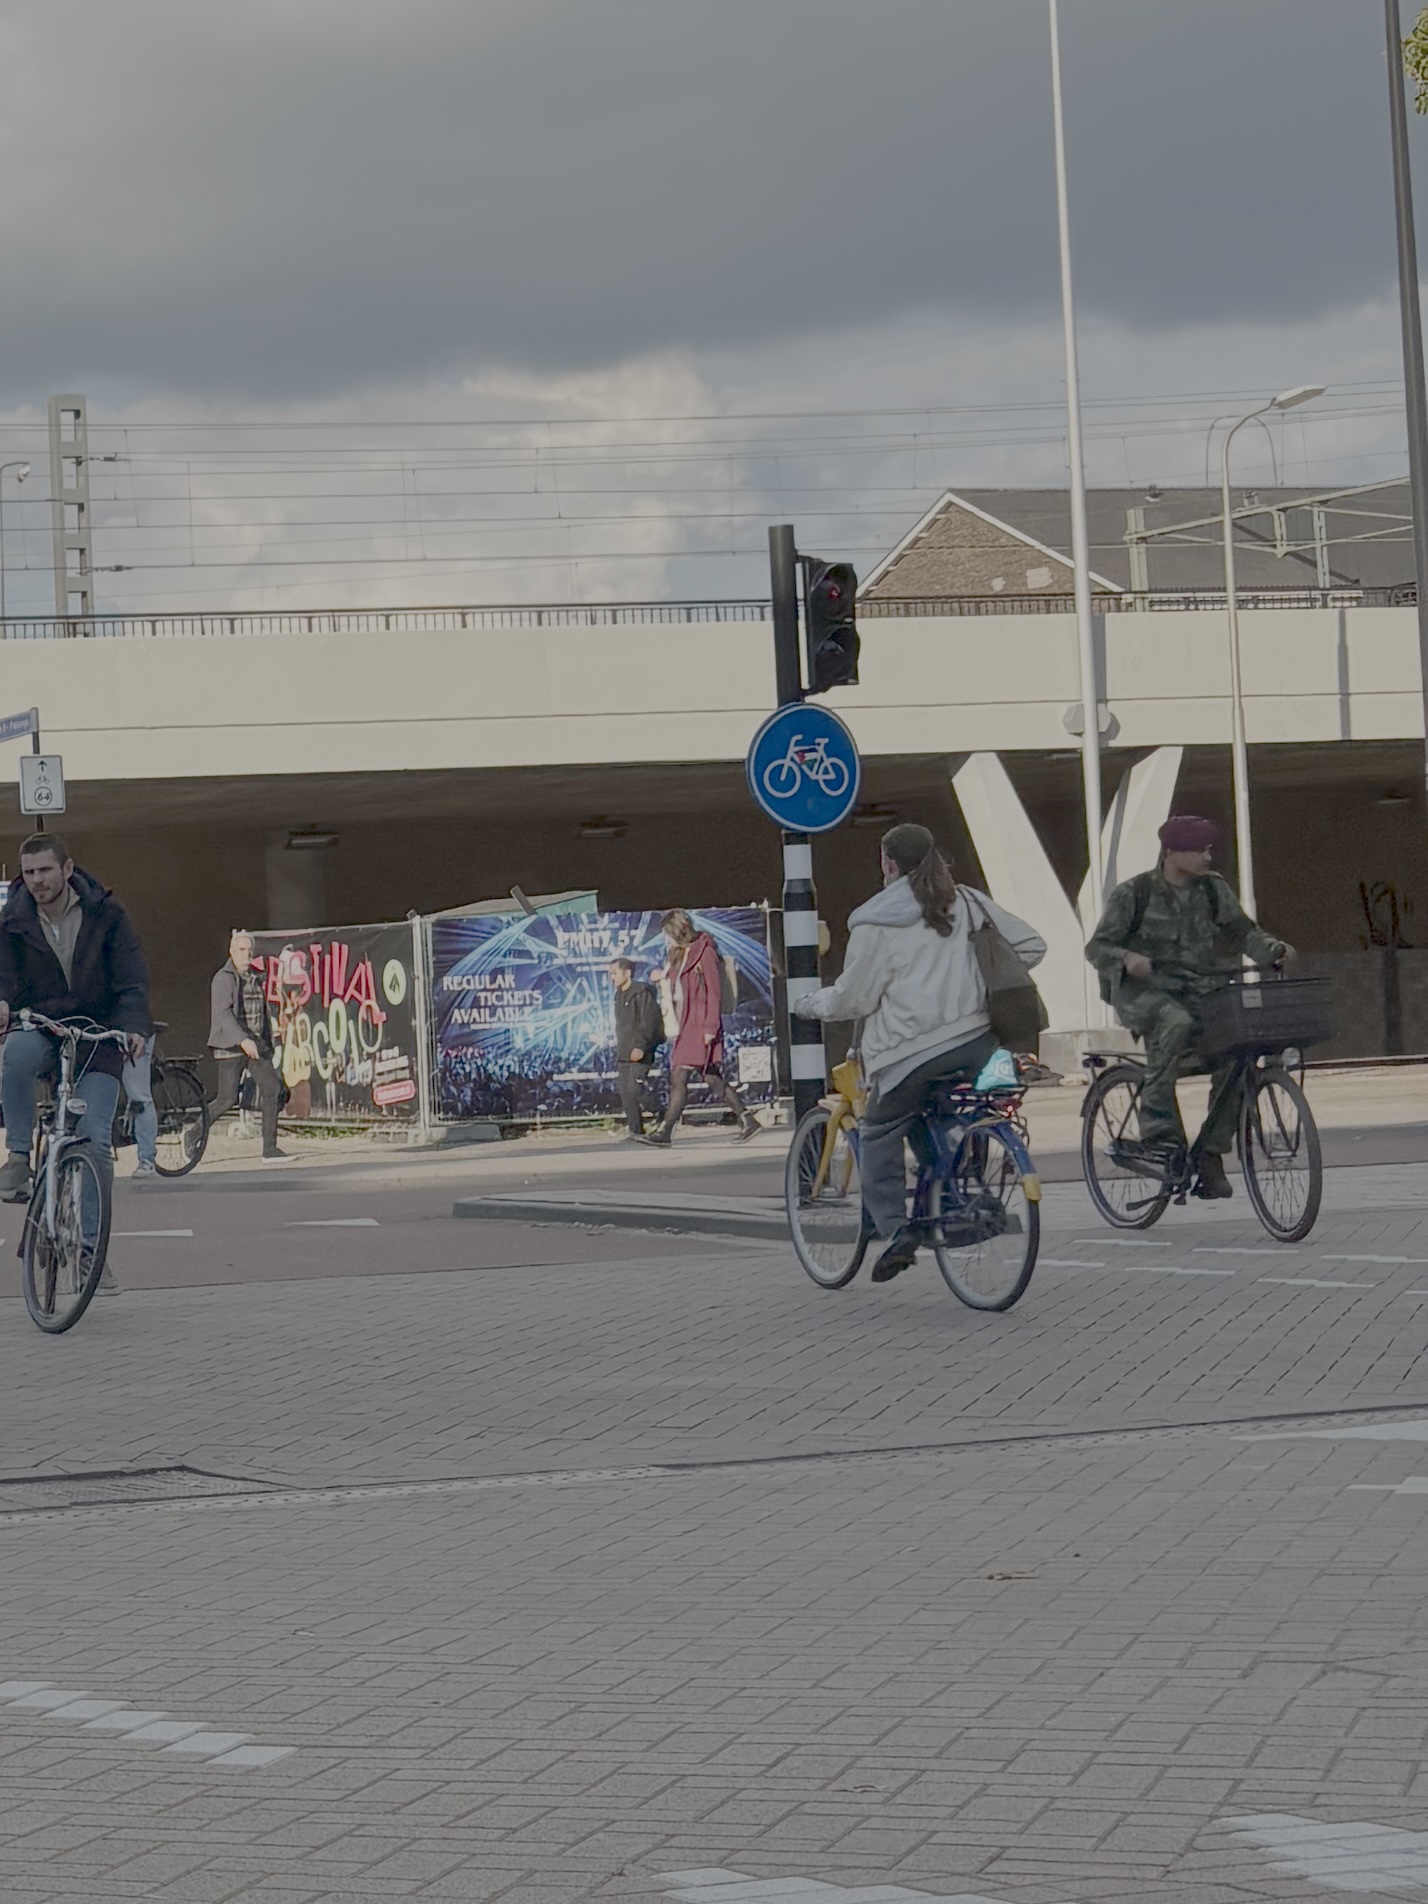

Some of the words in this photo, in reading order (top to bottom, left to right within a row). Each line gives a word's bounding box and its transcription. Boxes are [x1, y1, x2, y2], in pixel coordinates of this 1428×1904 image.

[250, 941, 387, 1024] ESTIVAL
[443, 974, 515, 990] REGULAR
[477, 990, 543, 1006] TICKETS
[451, 1006, 533, 1023] AVAILABLE
